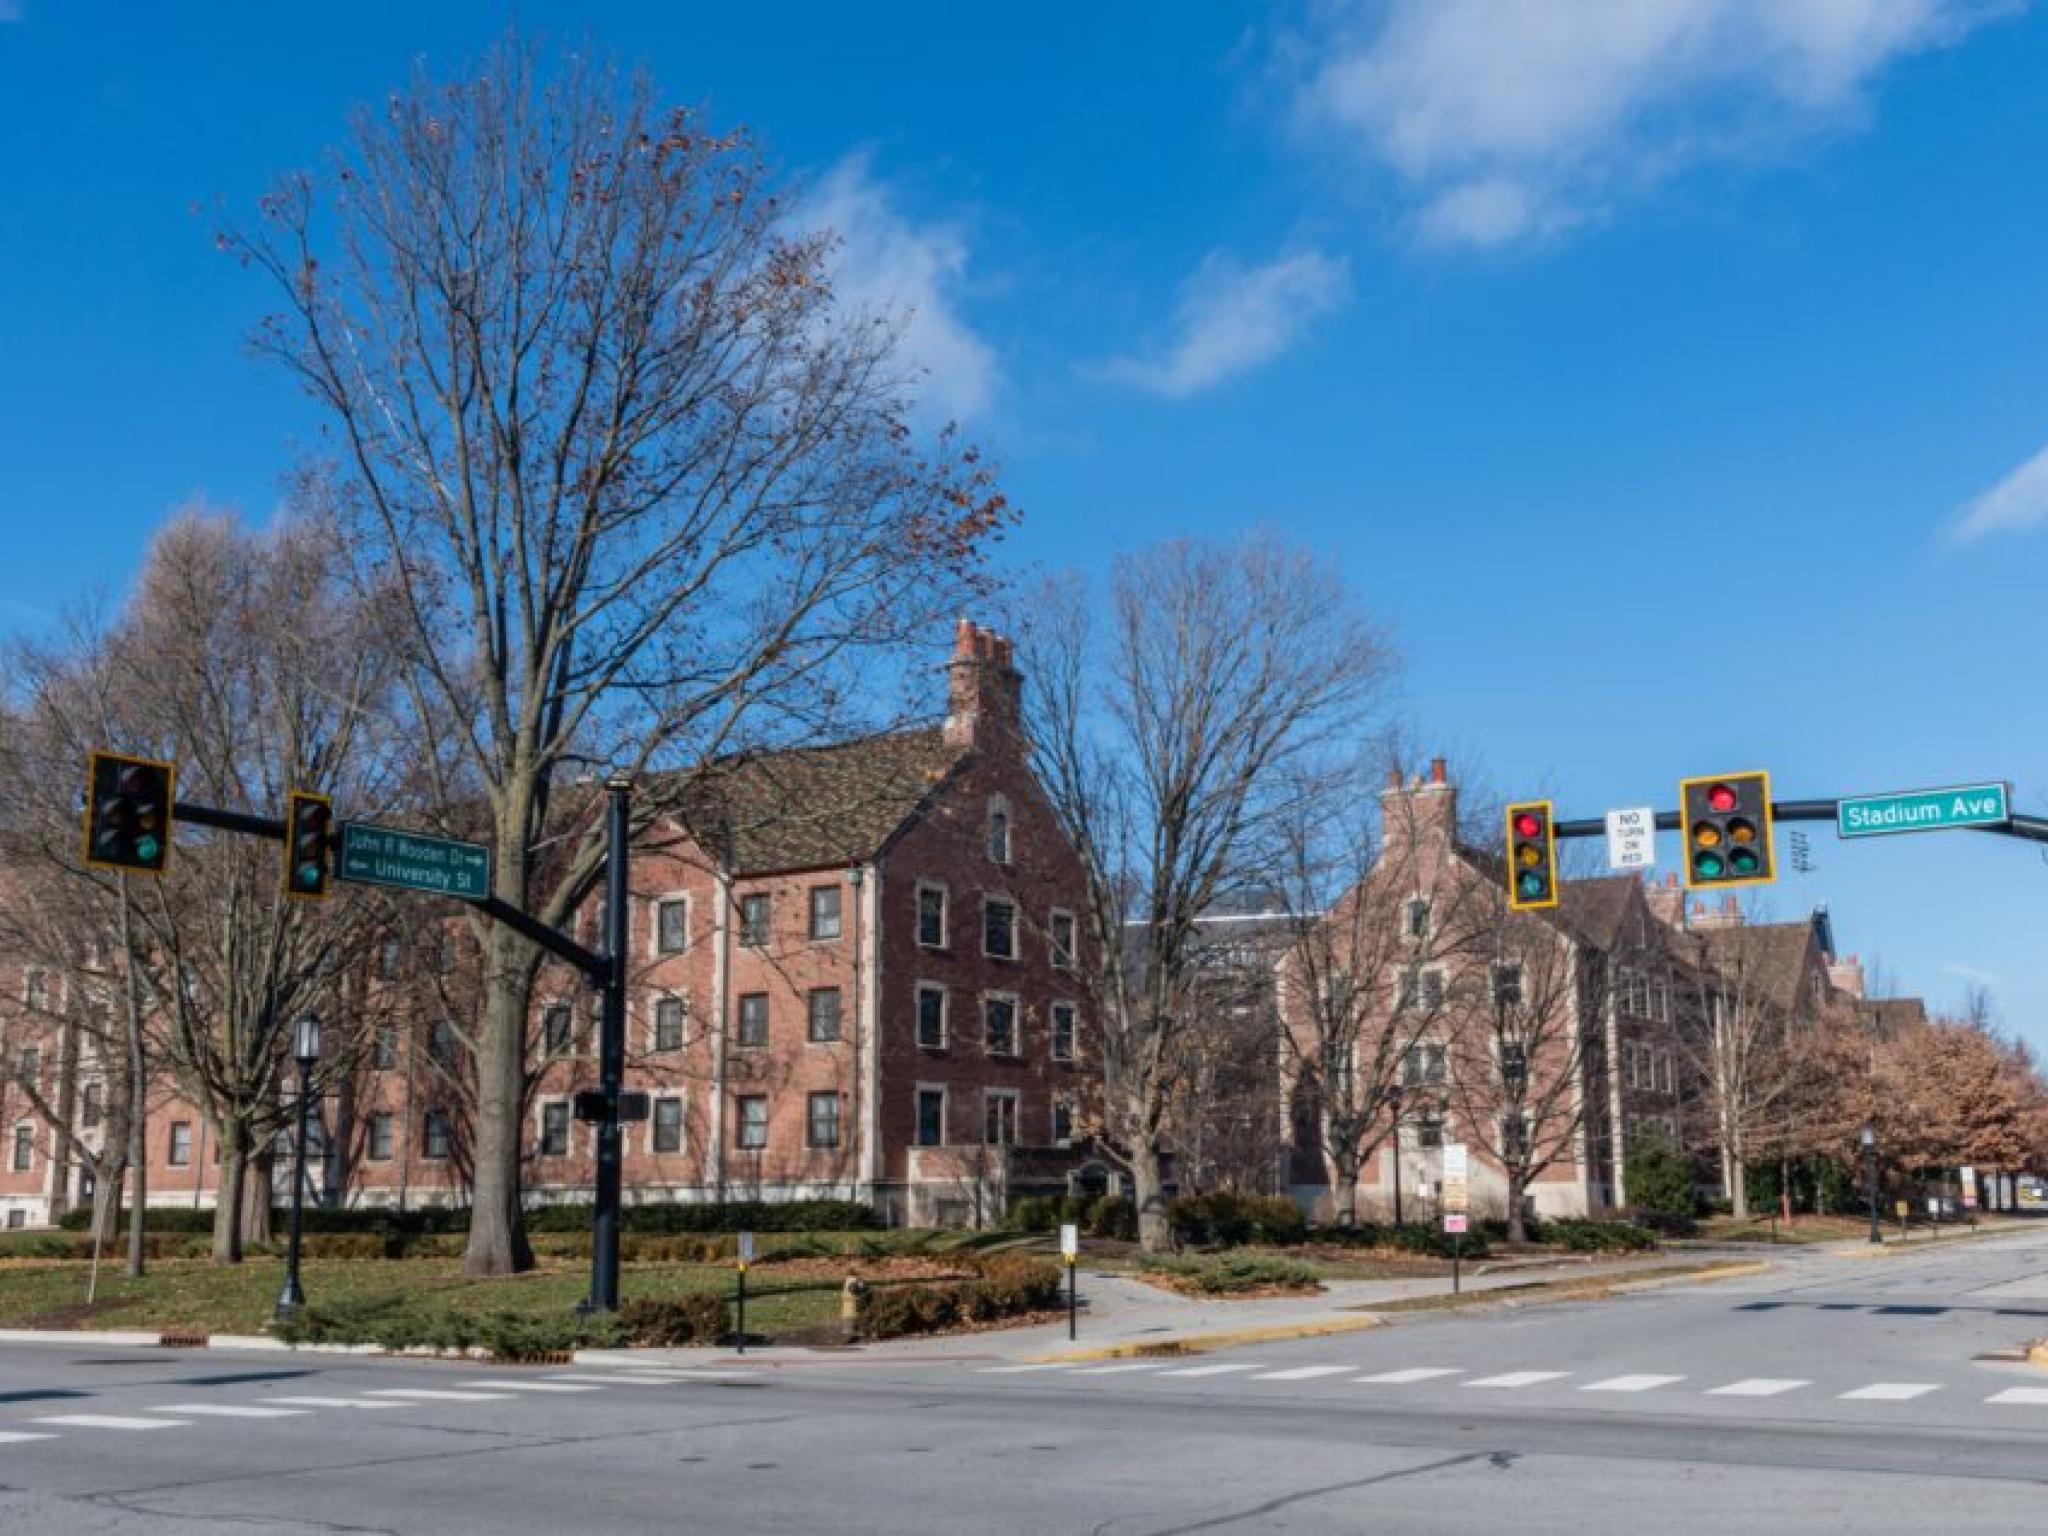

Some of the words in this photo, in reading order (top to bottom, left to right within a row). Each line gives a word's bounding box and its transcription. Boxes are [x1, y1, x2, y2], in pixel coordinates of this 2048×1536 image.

[1619, 812, 1641, 826] NO
[1849, 803, 1942, 827] Stadium
[1952, 797, 1997, 818] Ave
[375, 855, 450, 888] University
[457, 870, 472, 889] St
